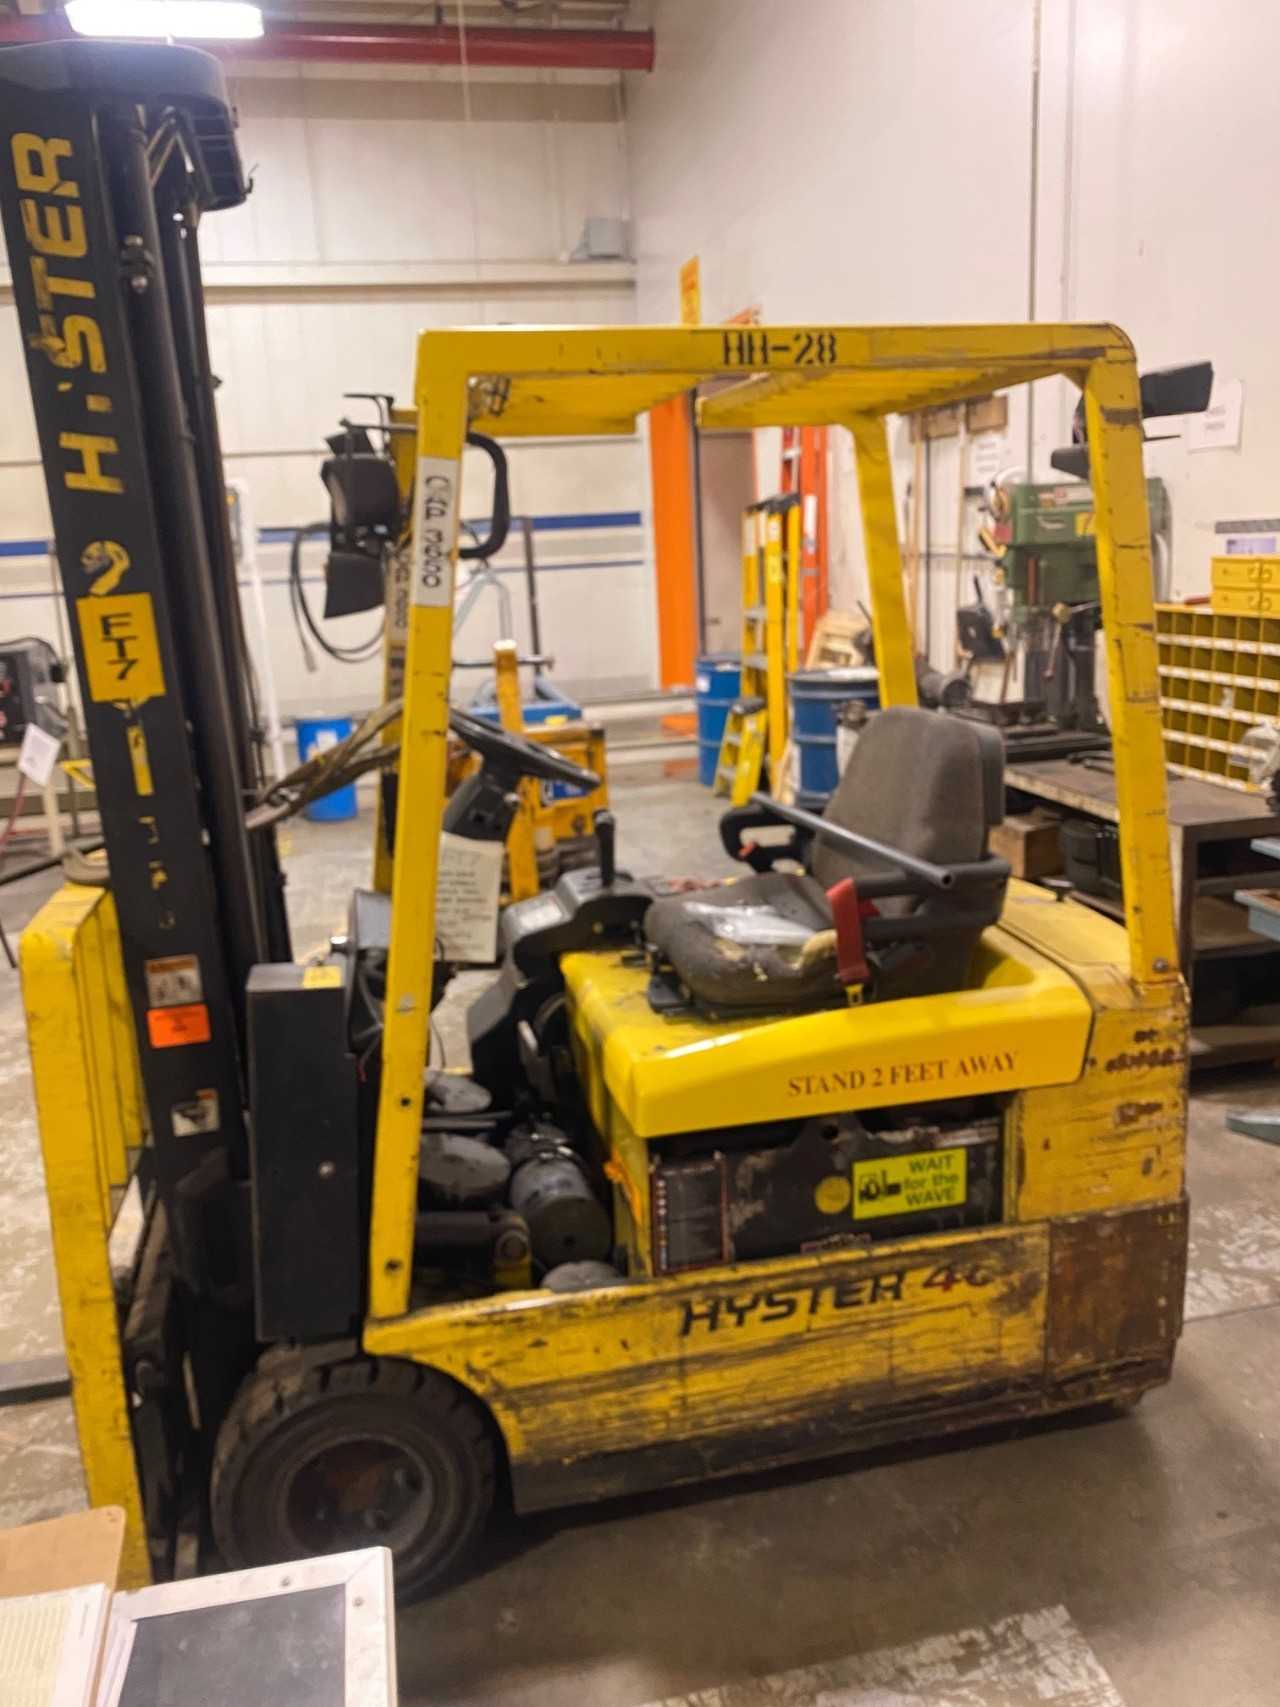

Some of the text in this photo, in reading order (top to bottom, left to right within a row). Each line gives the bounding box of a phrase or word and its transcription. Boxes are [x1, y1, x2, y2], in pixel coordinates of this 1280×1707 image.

[787, 1050, 1018, 1096] STAND 2 FEET AWAY
[909, 1154, 954, 1173] WAIT
[904, 1173, 959, 1190] for the
[905, 1188, 956, 1206] WAVE
[679, 1269, 905, 1337] HYSTER
